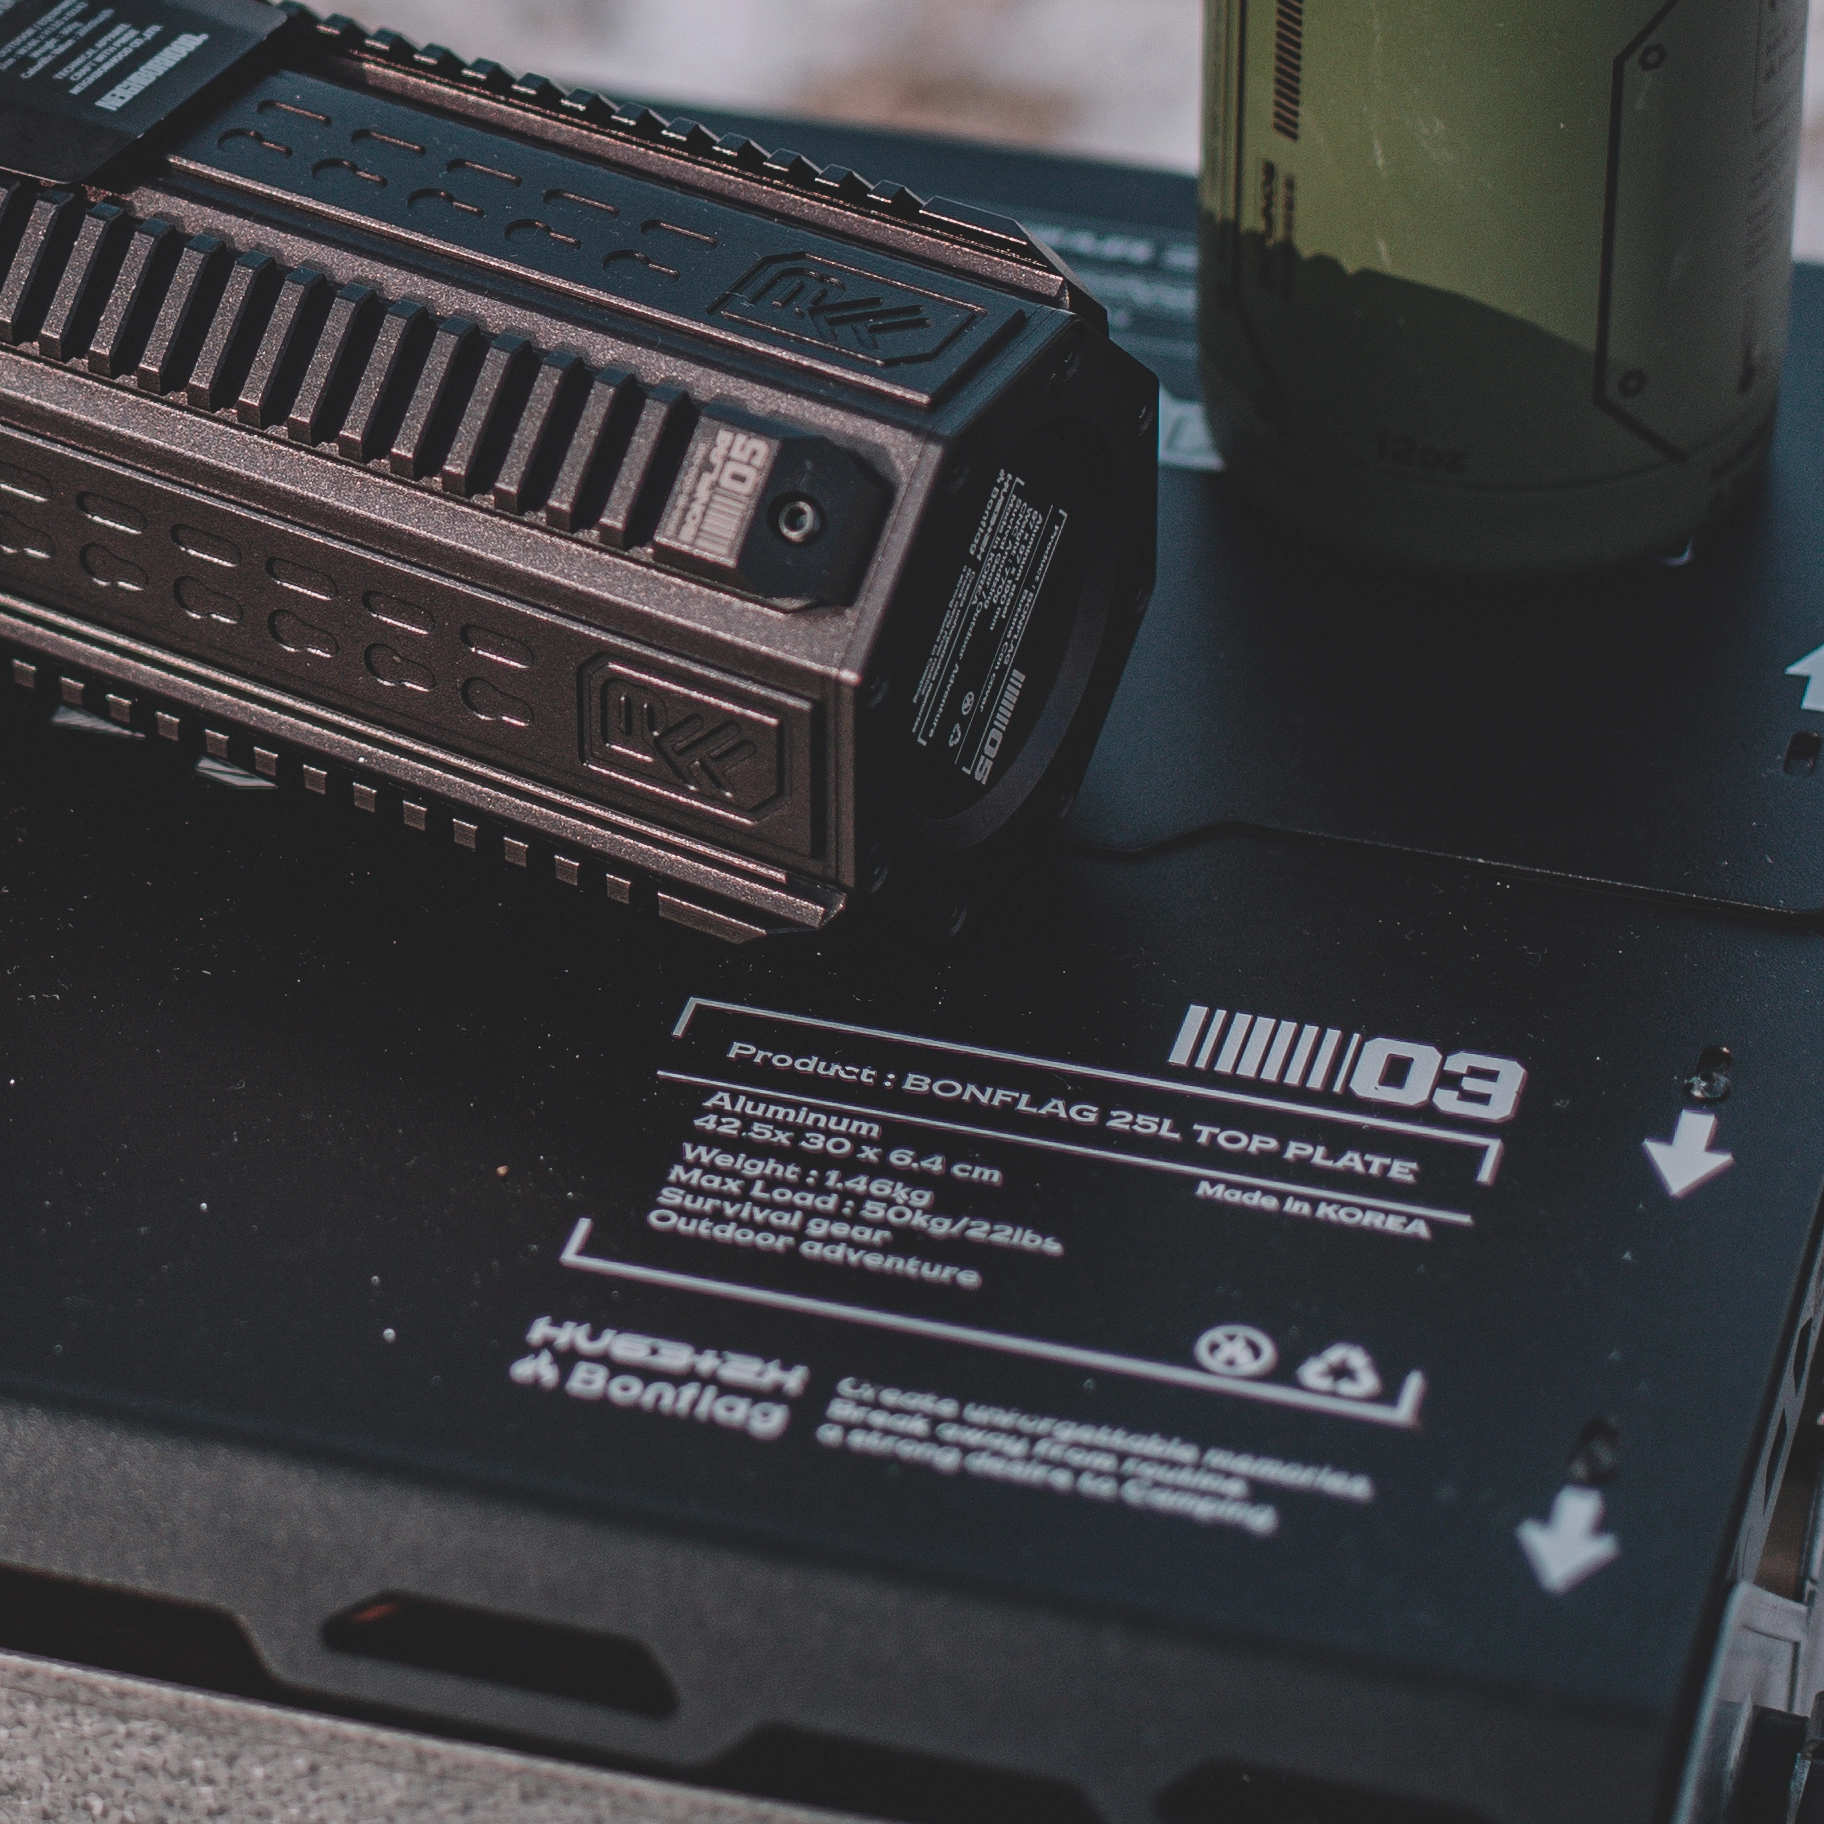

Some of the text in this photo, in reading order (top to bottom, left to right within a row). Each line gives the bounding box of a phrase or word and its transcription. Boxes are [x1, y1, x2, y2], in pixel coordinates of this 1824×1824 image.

[999, 494, 1016, 533] Made
[1011, 508, 1033, 555] Weight
[1012, 502, 1027, 536] CNC
[986, 553, 1001, 588] Gear
[1015, 514, 1043, 581] Aluminum
[971, 552, 995, 604] KOREA
[1003, 525, 1059, 665] Product BONFLAG
[959, 601, 984, 659] Outdoor
[980, 589, 1029, 712] Butane Can cover
[928, 663, 959, 737] Adventure
[1349, 1037, 1526, 1122] 03
[702, 1091, 880, 1138] Aluminum
[727, 1041, 876, 1083] Product
[902, 1073, 1099, 1123] BONFLAG
[1106, 1110, 1181, 1140] 25L
[1193, 1124, 1279, 1154] TOP
[1283, 1141, 1418, 1182] PLATE
[683, 1142, 800, 1181] Weight
[799, 1132, 852, 1154] 30
[857, 1145, 882, 1162] x
[889, 1149, 943, 1173] 6.4
[951, 1163, 1002, 1184] cm
[657, 1187, 891, 1244] Survival gear
[668, 1164, 744, 1194] Max
[750, 1179, 838, 1211] Load
[1196, 1180, 1430, 1238] Made in KOREA
[648, 1209, 981, 1287] Outdoor adventure
[565, 1361, 788, 1437] Bonflag
